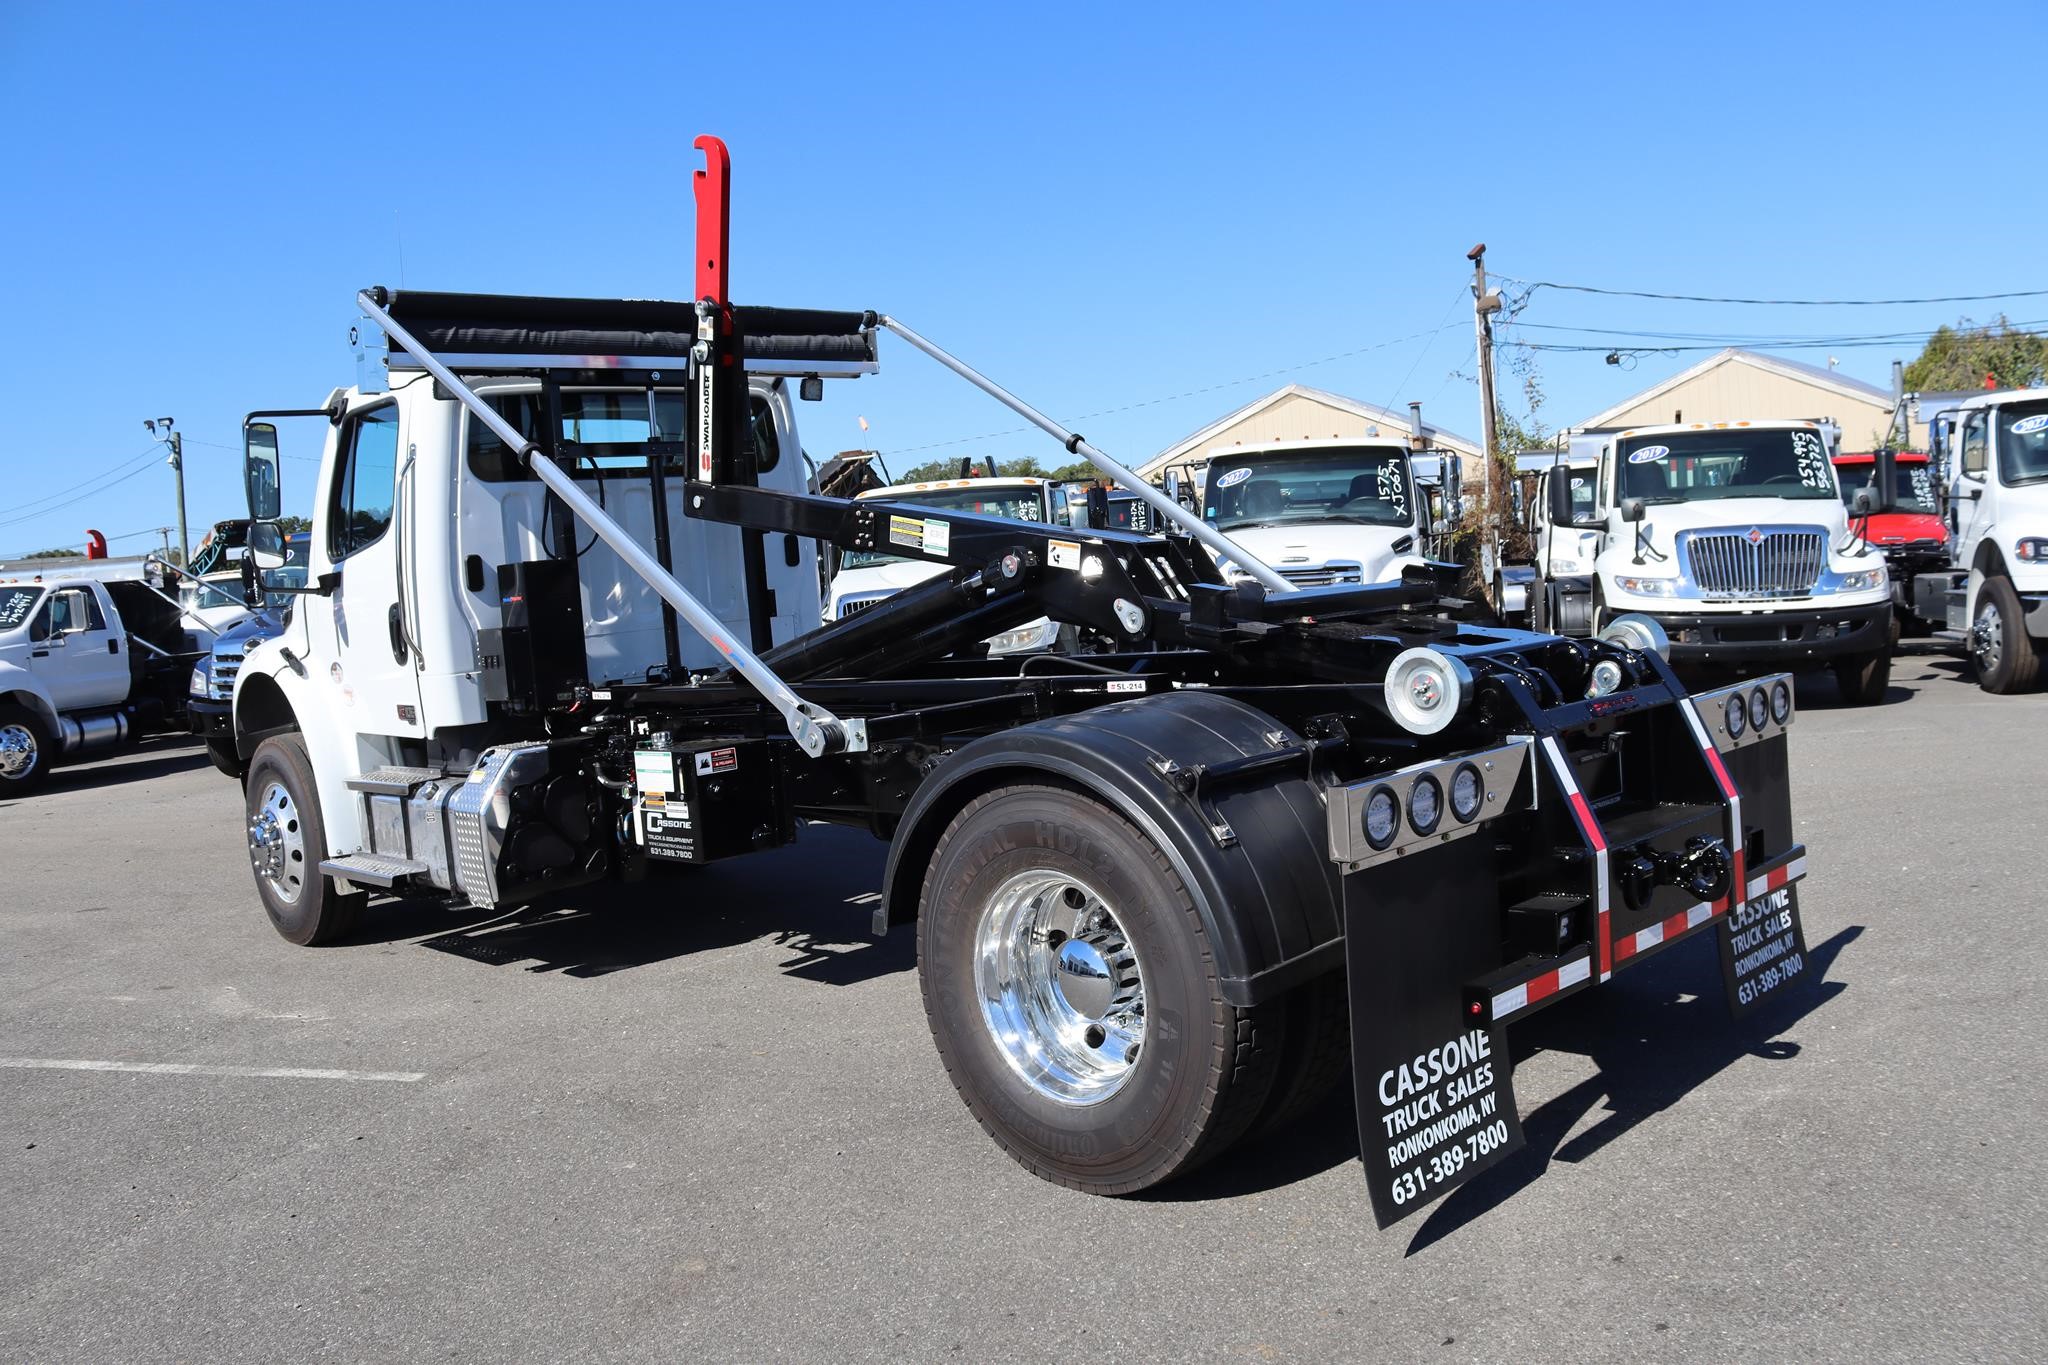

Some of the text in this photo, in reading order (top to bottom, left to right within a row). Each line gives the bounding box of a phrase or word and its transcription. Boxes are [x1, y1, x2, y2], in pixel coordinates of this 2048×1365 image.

[703, 375, 711, 450] SWAPLOADER
[1635, 447, 1662, 461] 2019
[1791, 431, 1816, 487] 254.995
[1377, 465, 1391, 501] 1575
[1388, 458, 1408, 517] XJ0674
[8, 595, 33, 623] 792941
[1116, 682, 1143, 691] SL-214
[650, 847, 693, 859] 631.389.7800
[666, 836, 694, 844] EQUIPMENT
[1731, 910, 1792, 956] TRUCK SALES
[1735, 931, 1794, 978] RONKONKOMA, NY
[1738, 953, 1803, 1005] 631-389-7800
[1378, 1029, 1492, 1107] CASSONE
[1383, 1062, 1494, 1139] TRUCK SALES
[1388, 1091, 1497, 1169] RONKONKOMA, NY
[1391, 1119, 1508, 1206] 631-389-7800
